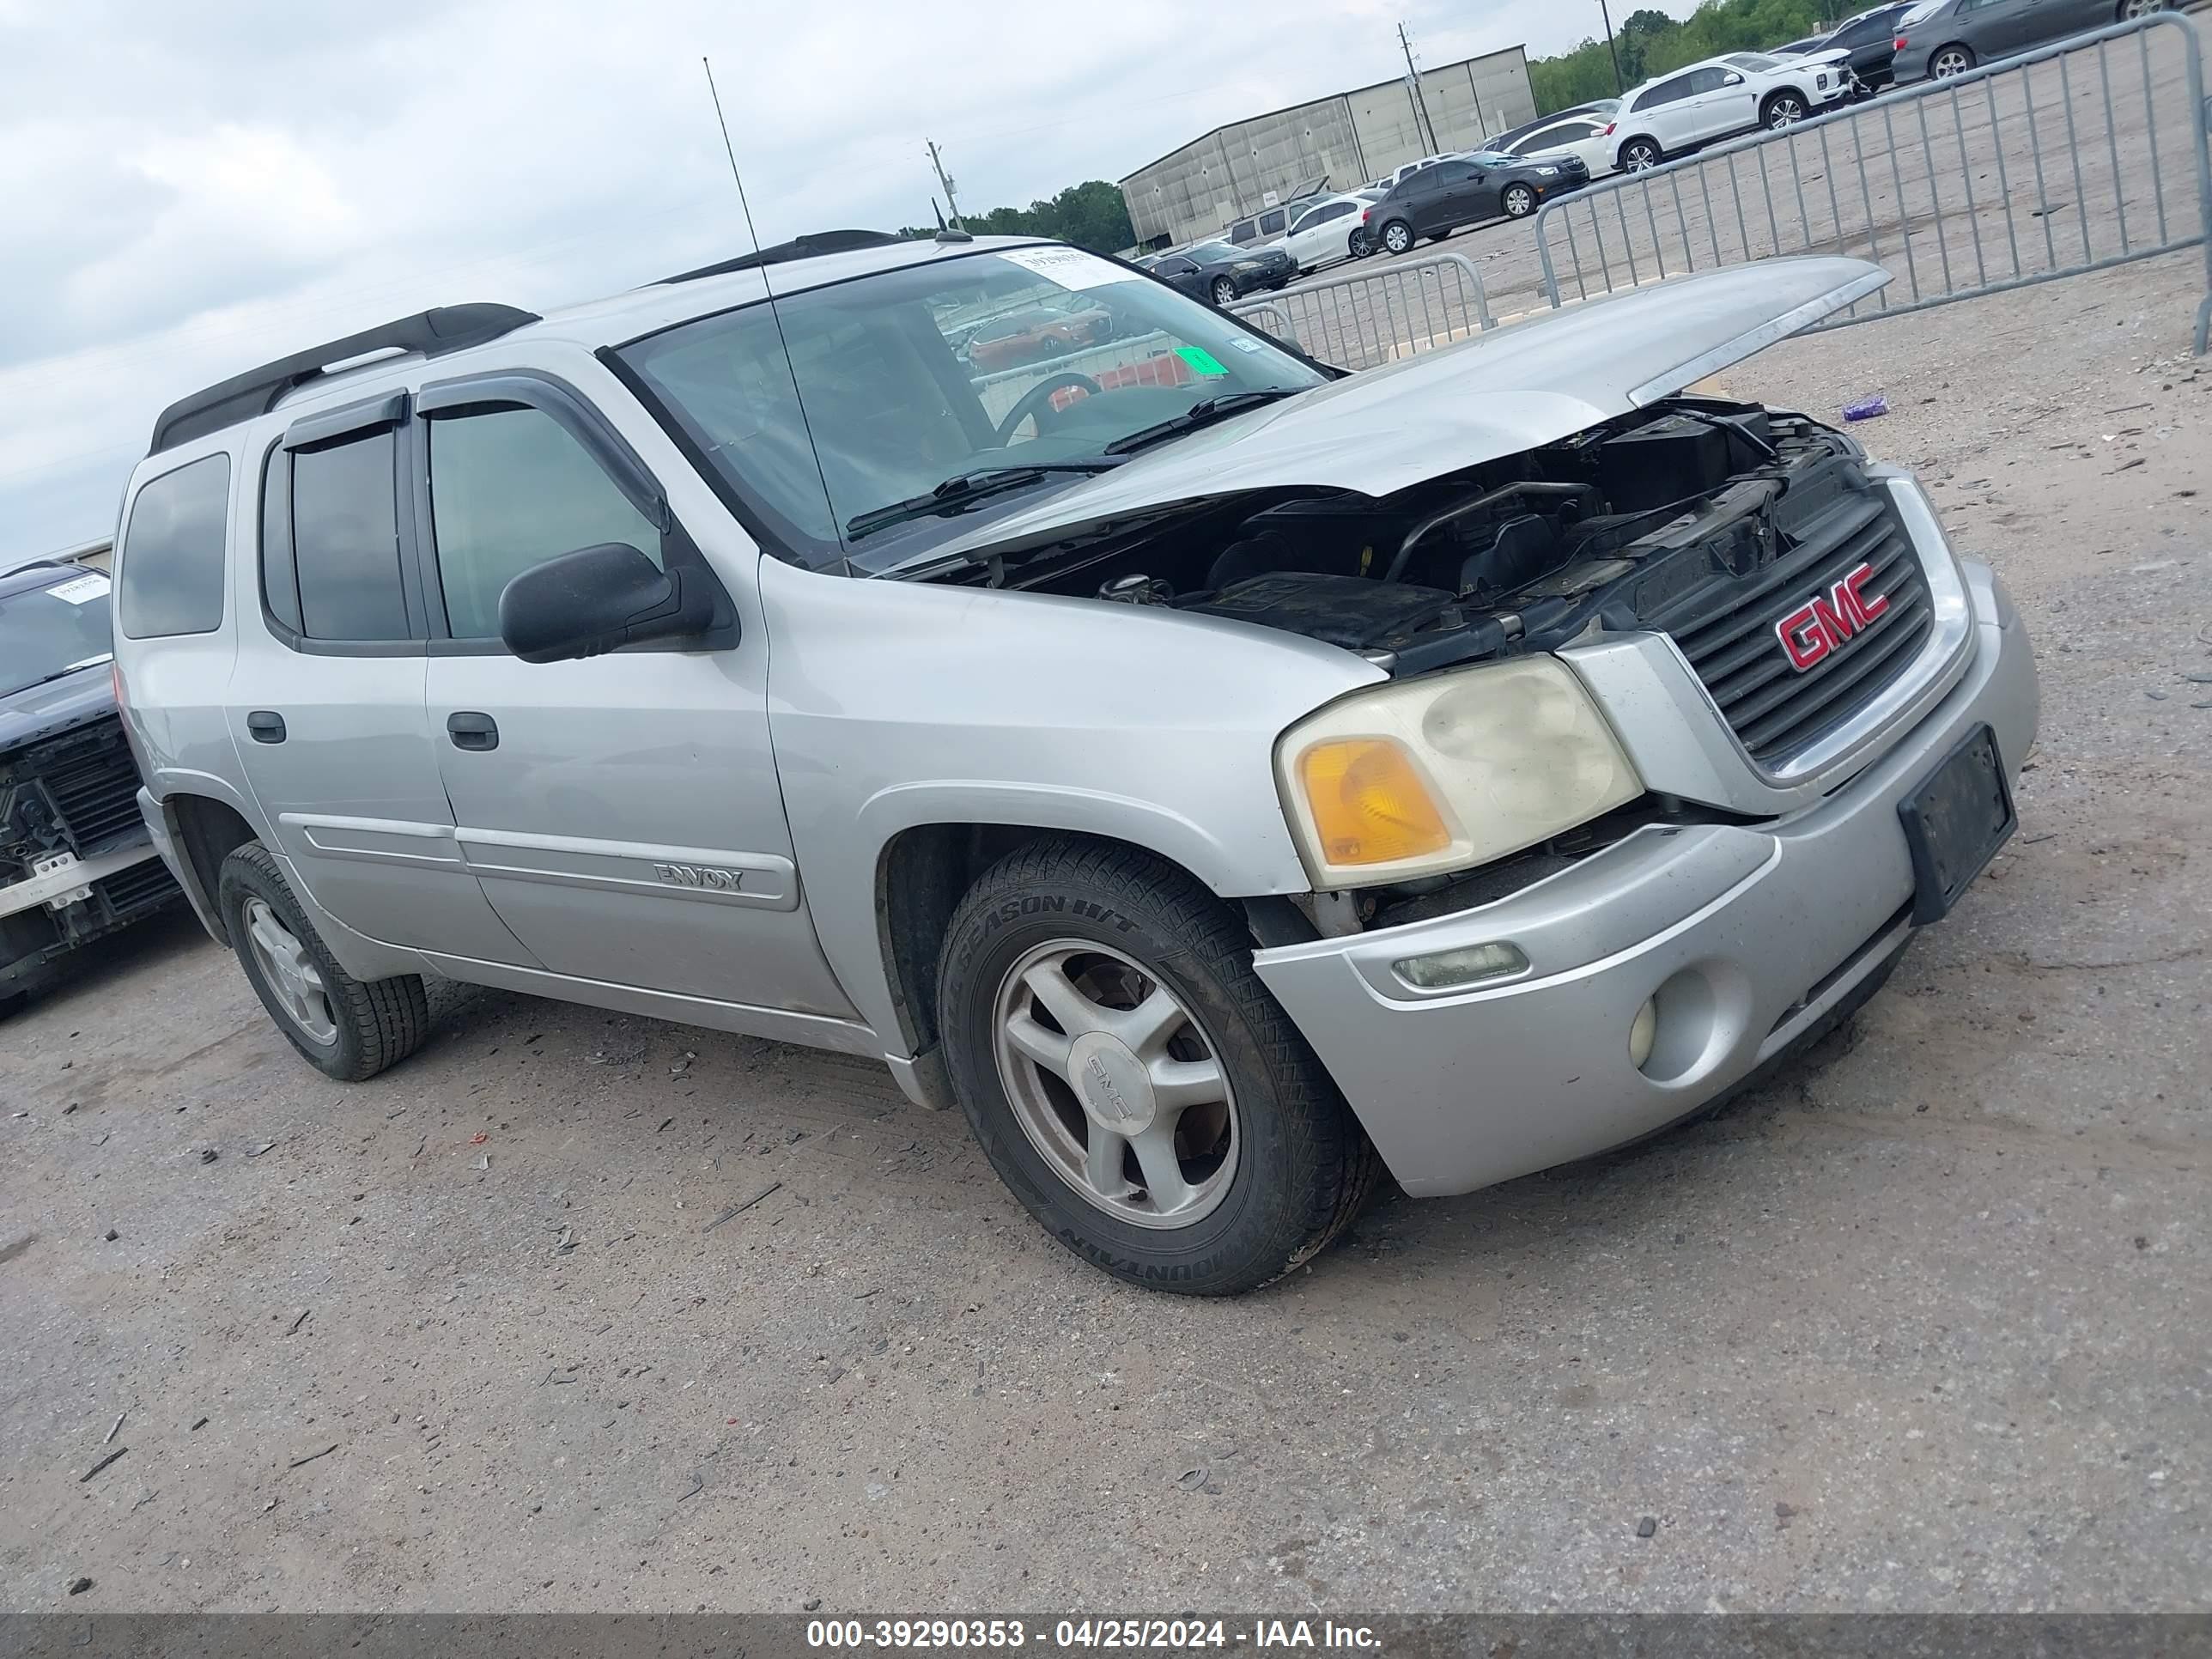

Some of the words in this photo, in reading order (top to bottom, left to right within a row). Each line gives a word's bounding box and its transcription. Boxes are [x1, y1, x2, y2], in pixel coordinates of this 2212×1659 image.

[1775, 562, 1890, 674] GMC
[653, 863, 744, 890] ENVOY
[961, 895, 1066, 972] SEASON
[1072, 898, 1140, 933] H/T
[1087, 1054, 1133, 1120] GMC
